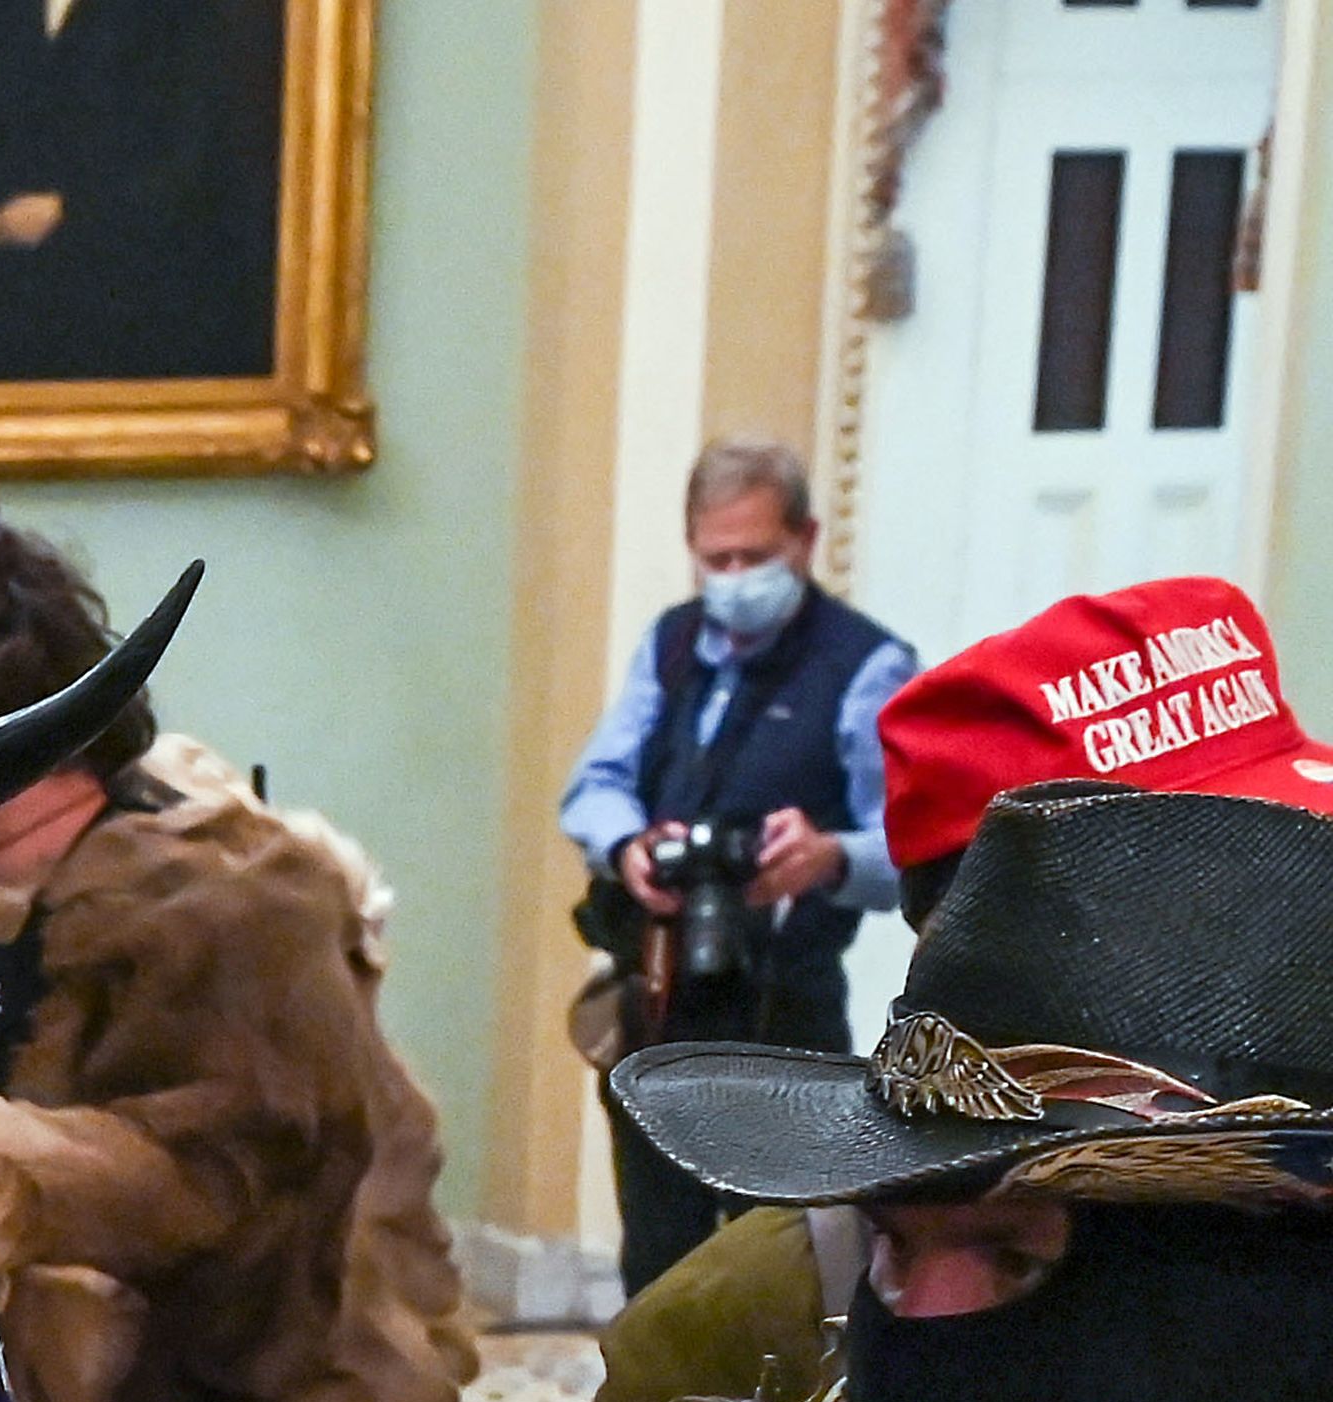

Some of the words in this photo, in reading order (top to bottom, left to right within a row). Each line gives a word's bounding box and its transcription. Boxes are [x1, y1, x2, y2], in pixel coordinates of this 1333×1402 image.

[1040, 651, 1152, 723] MAKE
[1145, 616, 1262, 690] AMERICA
[1083, 691, 1201, 774] GREAT
[1197, 669, 1279, 737] AGAIN
